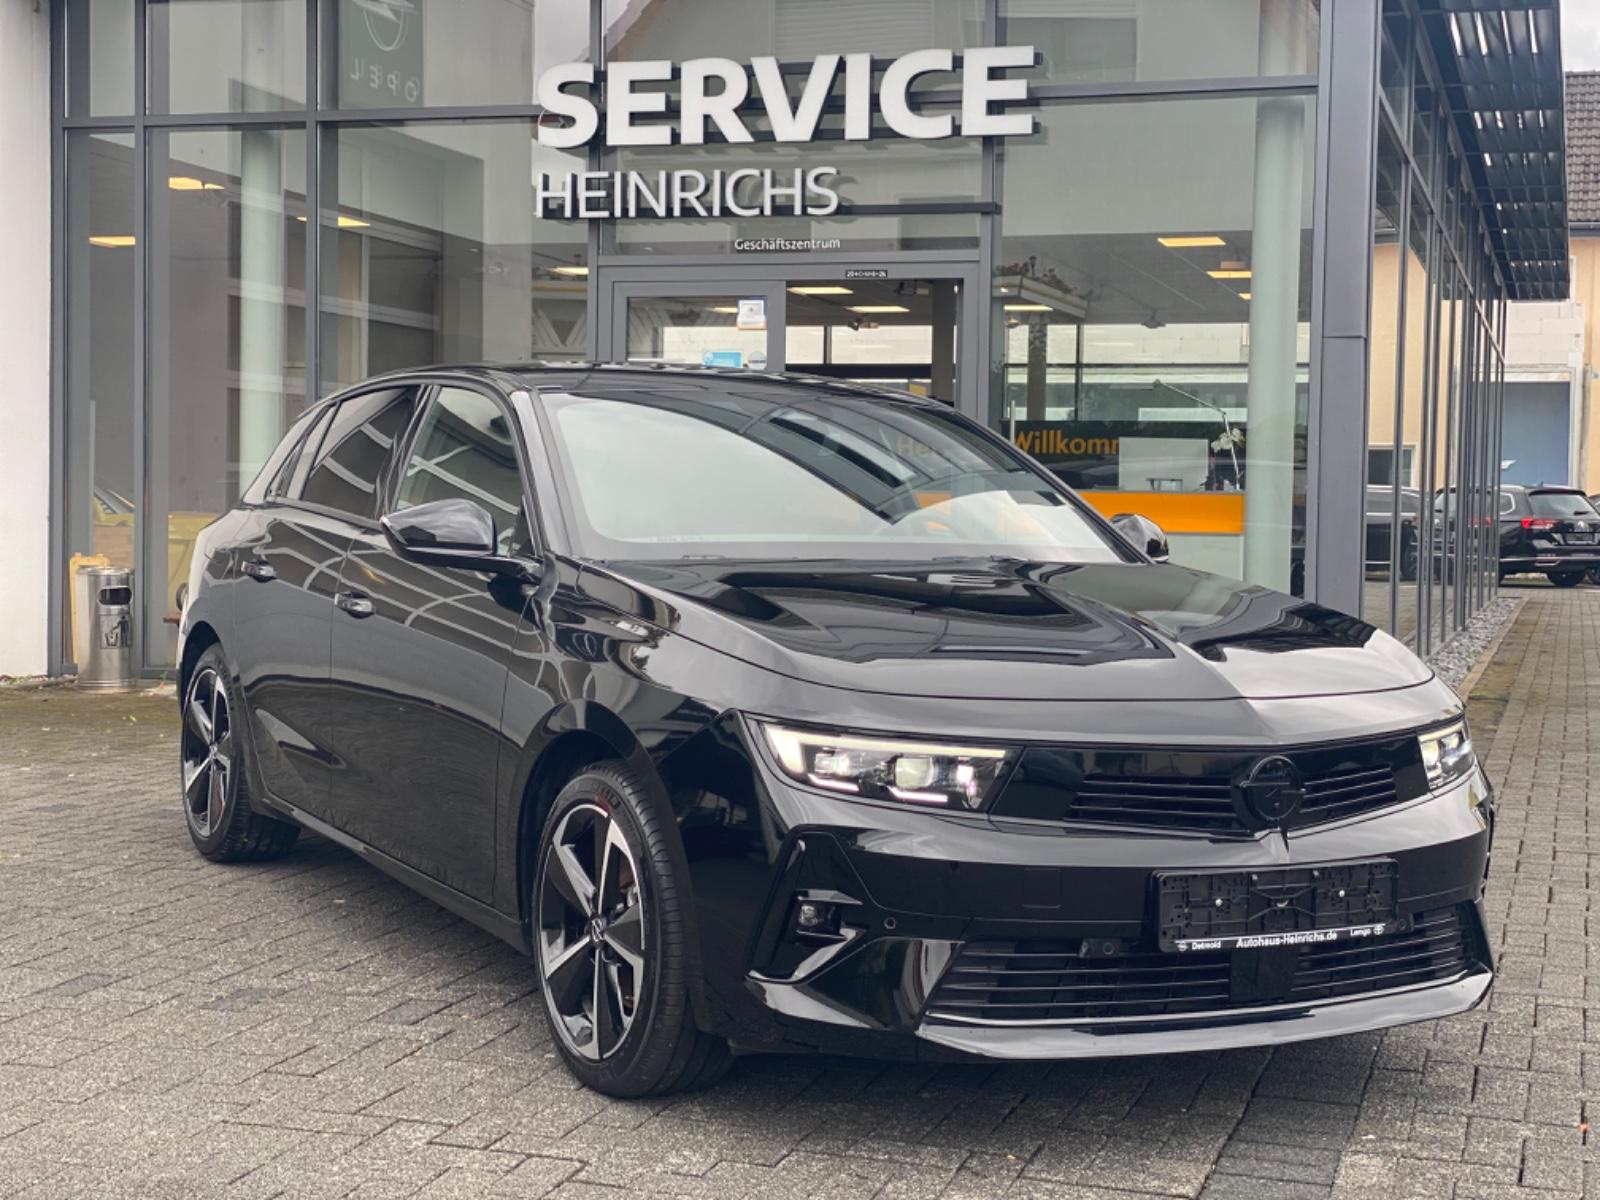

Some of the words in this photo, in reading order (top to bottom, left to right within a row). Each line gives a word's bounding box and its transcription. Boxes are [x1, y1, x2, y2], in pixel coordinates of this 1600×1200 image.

[537, 45, 1038, 149] SERVICE
[535, 166, 839, 218] HEINRICHS
[734, 239, 841, 250] Geschäftszentrum
[1192, 940, 1221, 950] Detmold
[1236, 931, 1337, 949] Autohaus-Heinrichs.de
[1350, 927, 1371, 938] Lemgo
